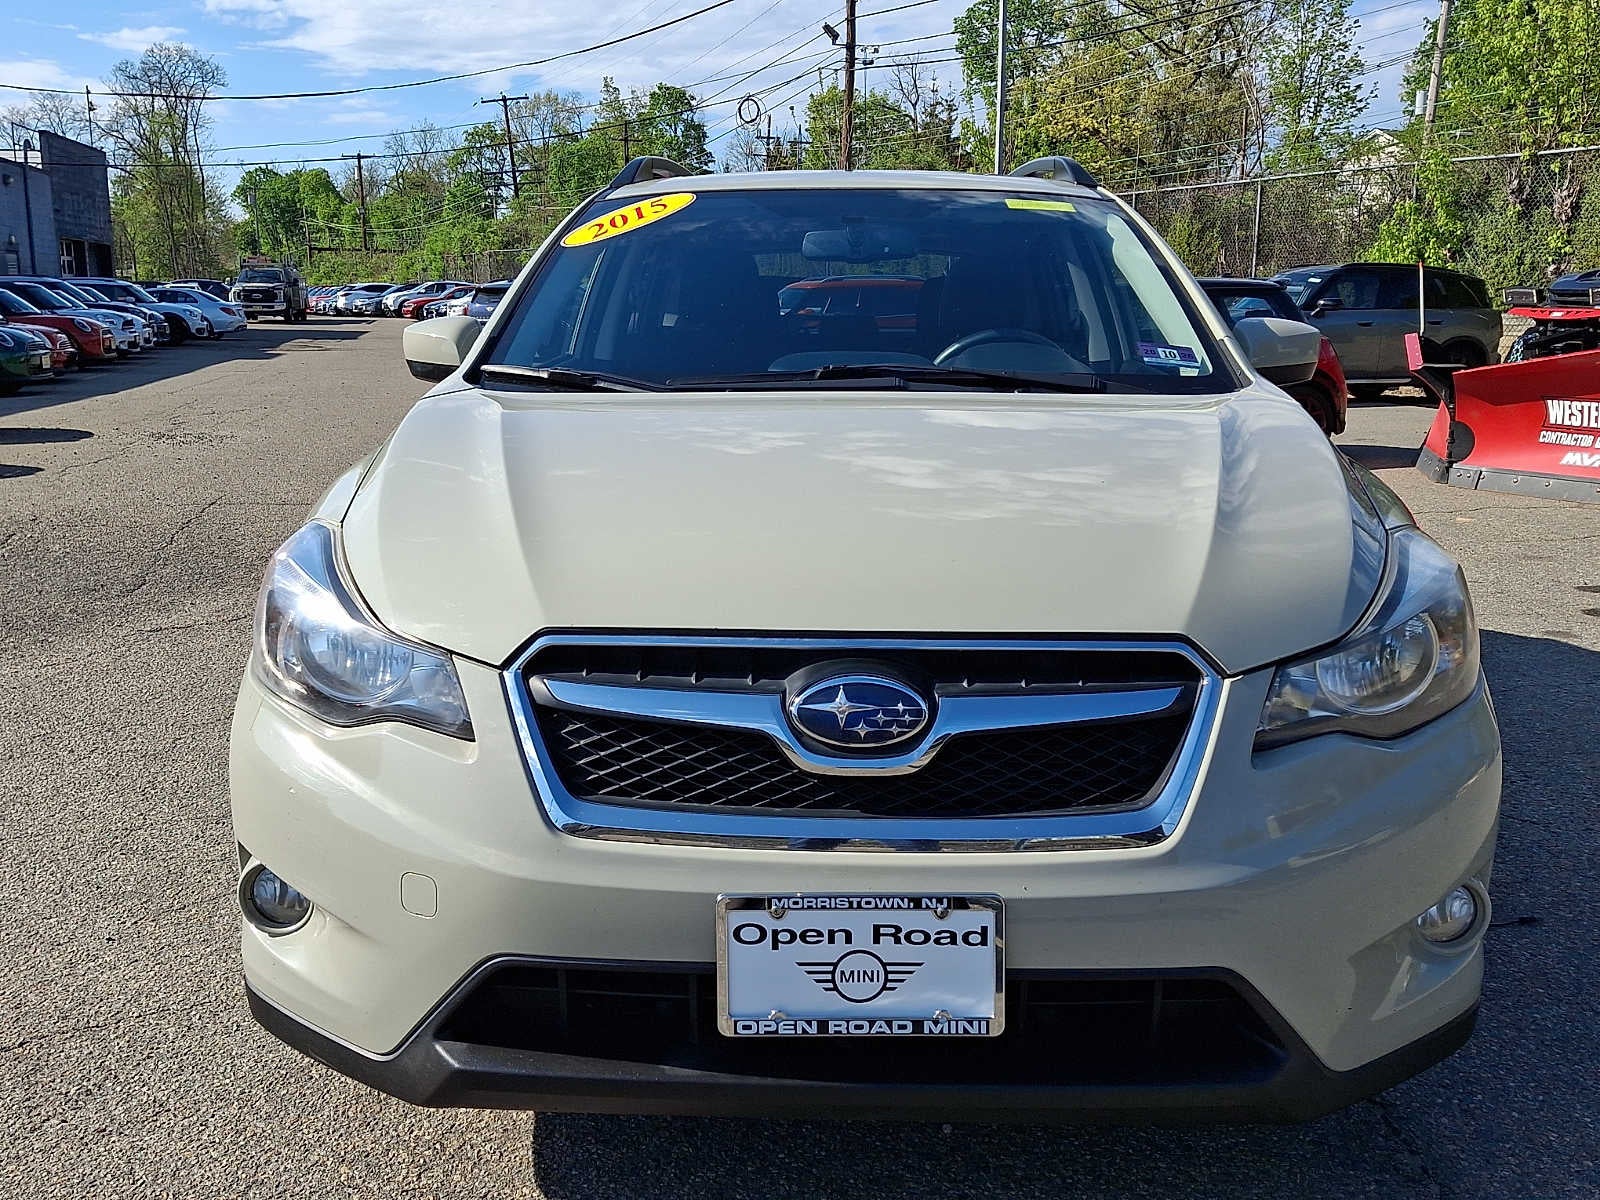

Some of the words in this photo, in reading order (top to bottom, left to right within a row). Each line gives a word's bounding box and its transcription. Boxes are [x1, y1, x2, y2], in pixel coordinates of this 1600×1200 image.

[588, 198, 668, 240] 2015
[1161, 350, 1177, 359] 10
[1546, 399, 1600, 428] WESTE
[771, 897, 914, 909] MORRISTOWN,
[921, 898, 948, 910] NJ
[732, 922, 853, 951] Open
[872, 923, 989, 947] Road
[839, 969, 880, 984] MINI
[736, 1020, 818, 1035] OPEN
[828, 1020, 913, 1035] ROAD
[923, 1020, 987, 1035] MINI
